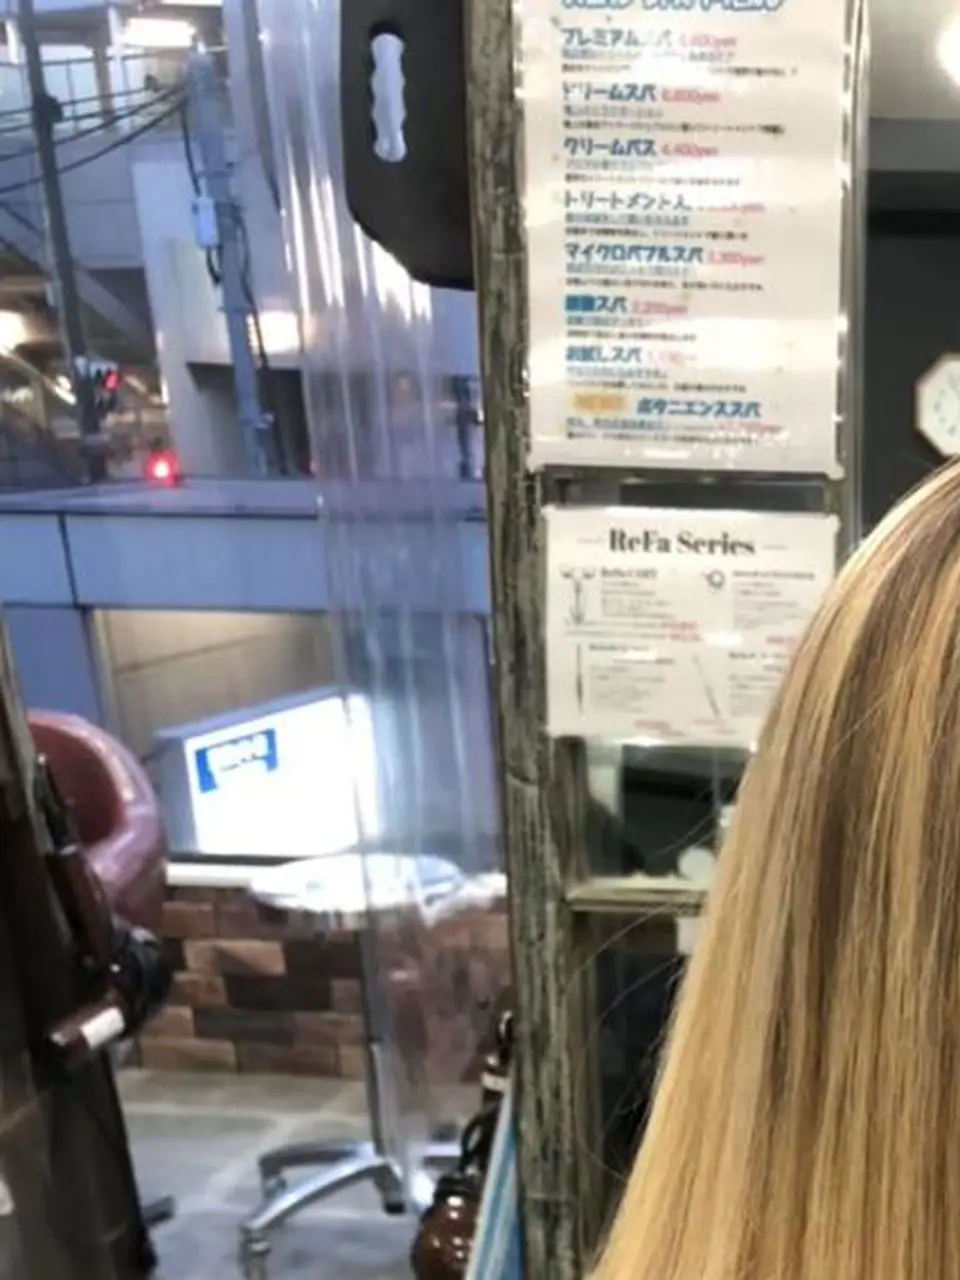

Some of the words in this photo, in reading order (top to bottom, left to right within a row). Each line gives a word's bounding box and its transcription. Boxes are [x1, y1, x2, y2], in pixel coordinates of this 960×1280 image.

[562, 27, 672, 48] プレミアムパ
[564, 138, 657, 157] クリームバス
[565, 242, 704, 264] マイクロバブルスパ
[609, 528, 671, 553] ReFa
[677, 531, 756, 555] Series
